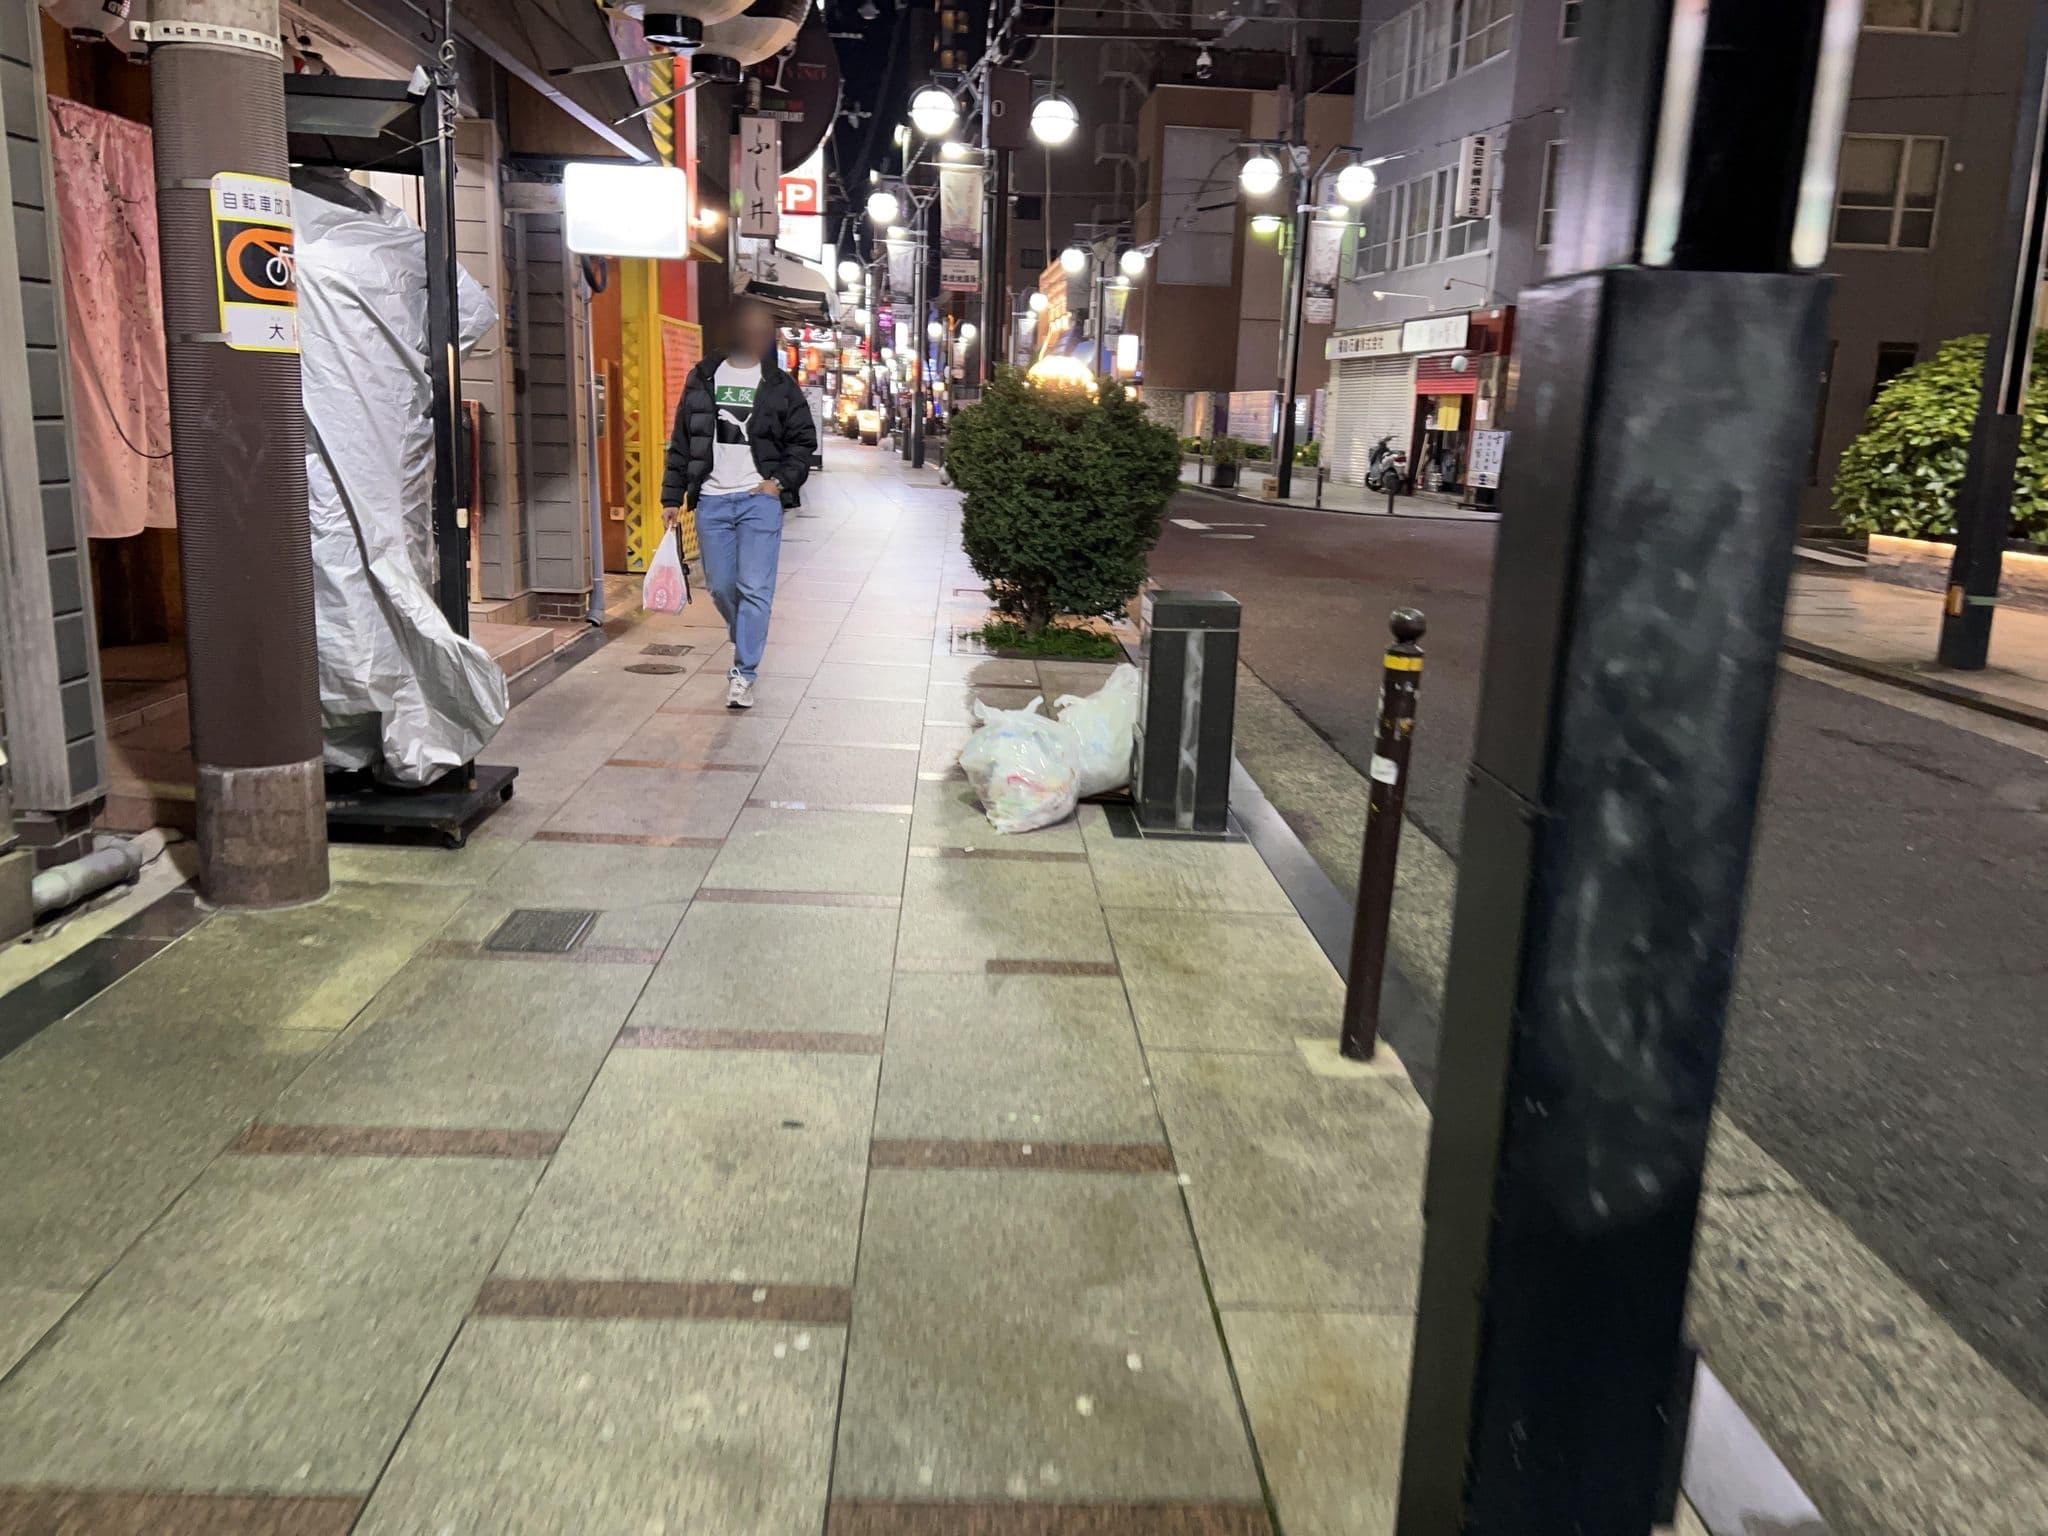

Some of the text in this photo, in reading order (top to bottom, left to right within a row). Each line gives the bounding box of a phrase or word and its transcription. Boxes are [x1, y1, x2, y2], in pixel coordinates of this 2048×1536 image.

[746, 121, 772, 230] ふじ井
[785, 183, 813, 211] P
[721, 387, 753, 403] 大阪
